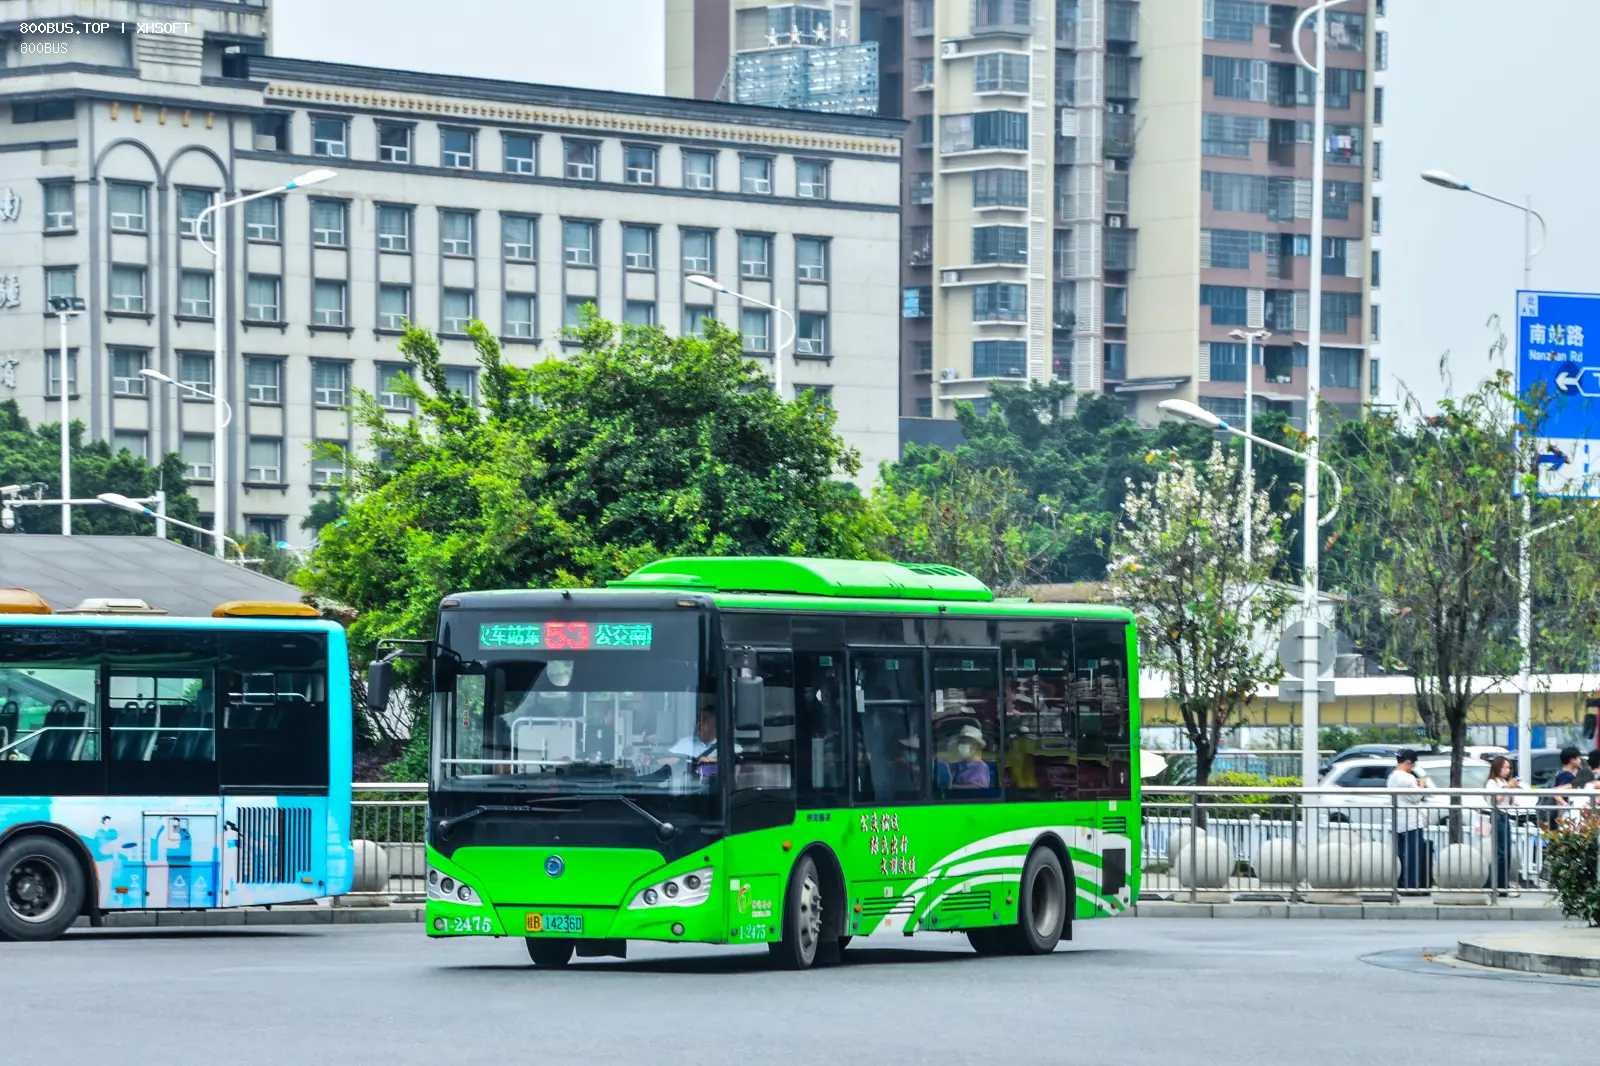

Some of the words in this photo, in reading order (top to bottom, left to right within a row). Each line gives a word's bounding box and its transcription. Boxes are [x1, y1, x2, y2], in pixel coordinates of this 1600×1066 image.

[1529, 323, 1585, 347] 南站路
[1570, 350, 1583, 363] Rd
[544, 621, 589, 650] 53
